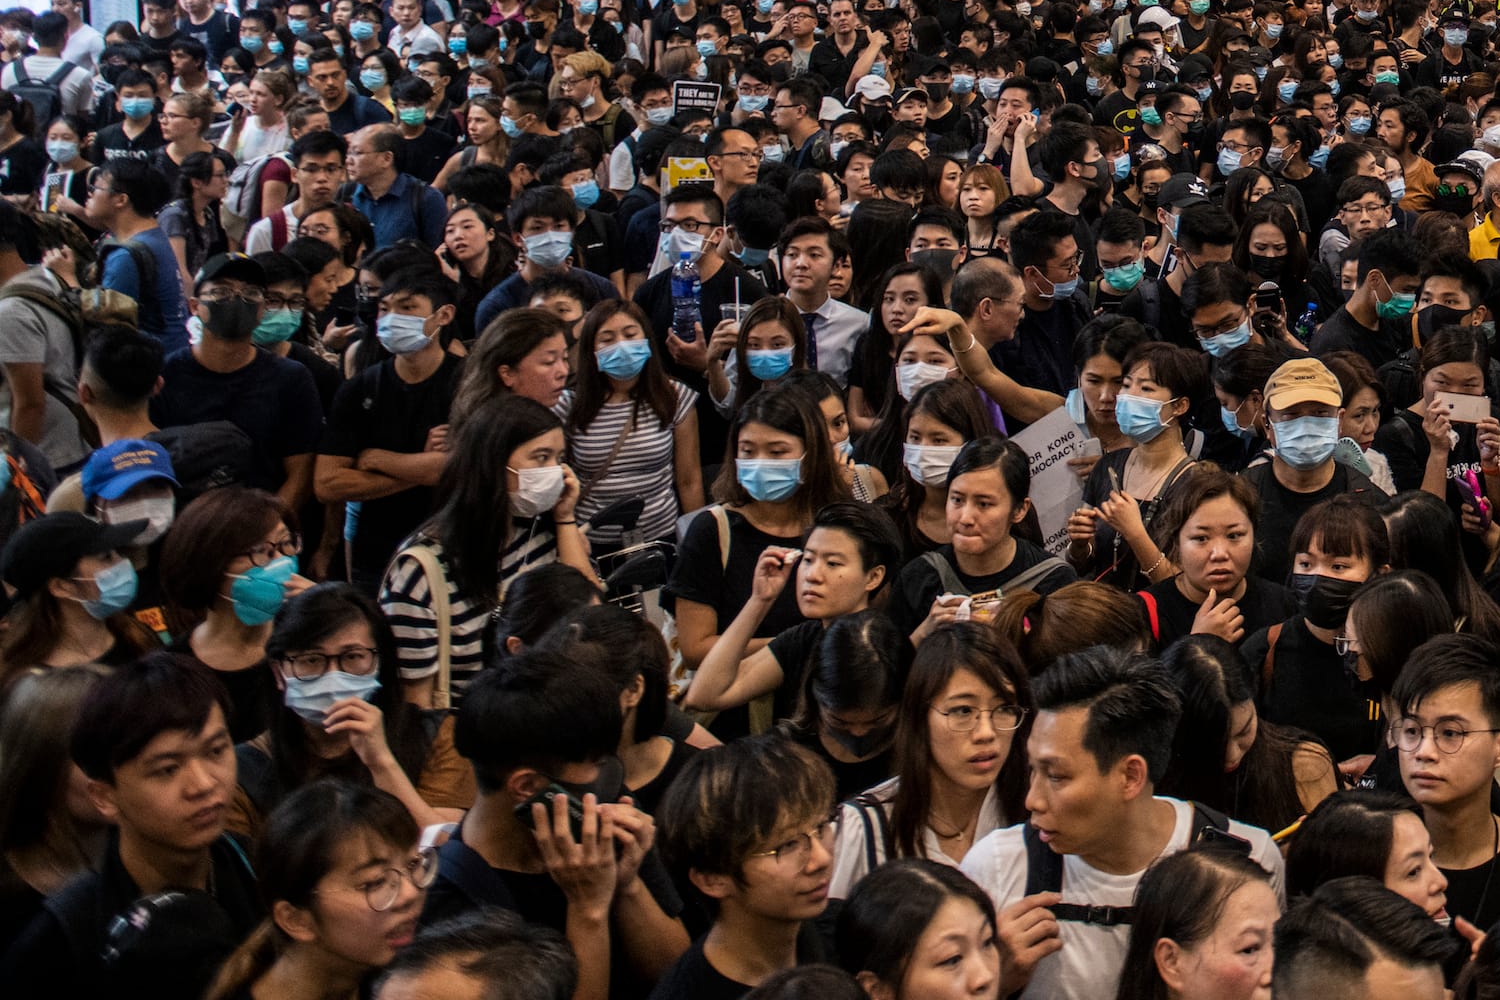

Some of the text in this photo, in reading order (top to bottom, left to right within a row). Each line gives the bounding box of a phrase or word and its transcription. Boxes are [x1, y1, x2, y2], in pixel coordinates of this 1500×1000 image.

[678, 87, 698, 98] THEY
[1047, 430, 1075, 453] KONG
[1029, 442, 1076, 478] MOCRACY
